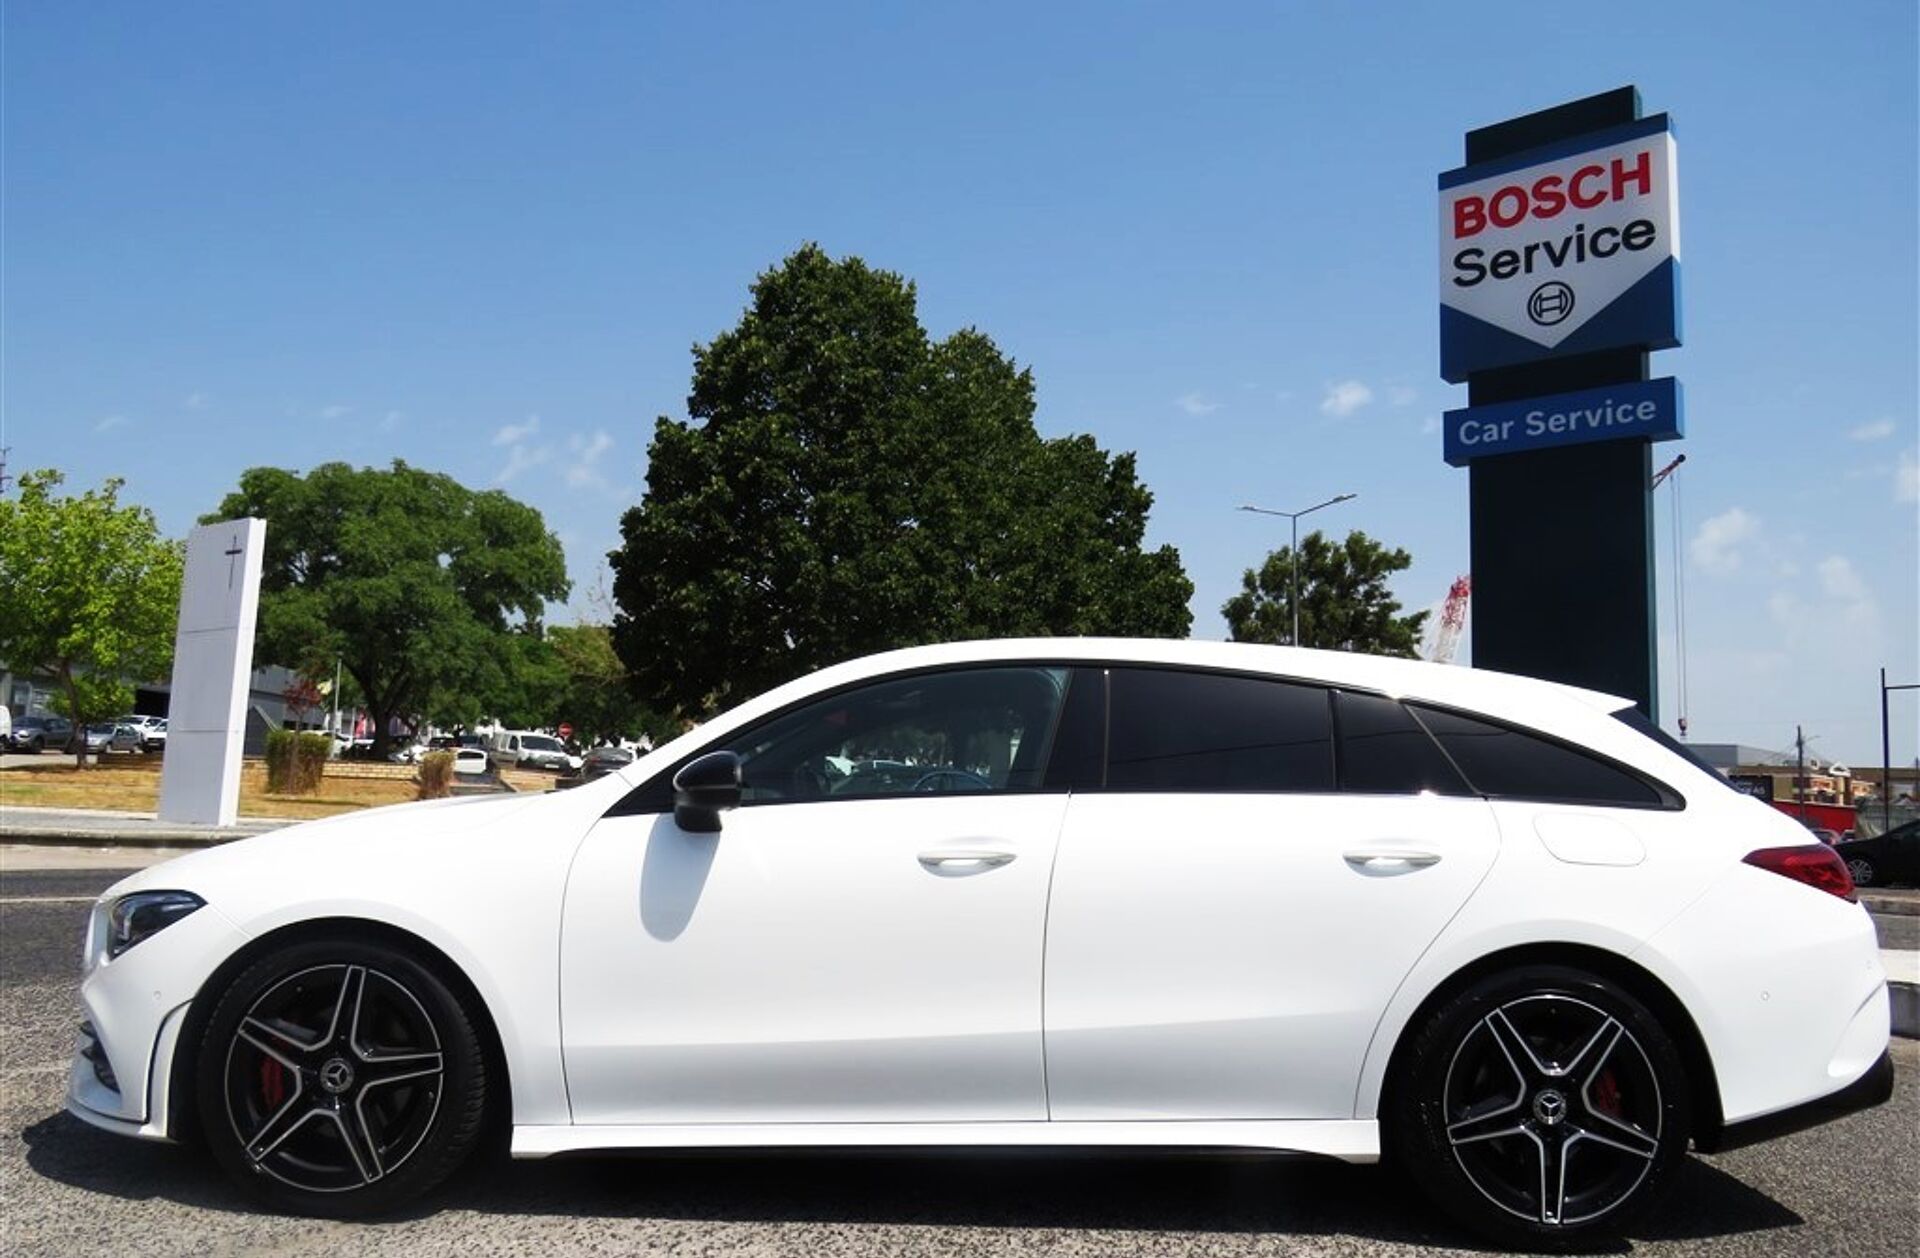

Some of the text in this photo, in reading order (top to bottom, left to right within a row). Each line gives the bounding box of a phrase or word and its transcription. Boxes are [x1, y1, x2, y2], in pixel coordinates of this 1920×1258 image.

[1454, 152, 1651, 239] BOSCH
[1453, 219, 1656, 287] Service
[1459, 399, 1657, 445] Car Service
